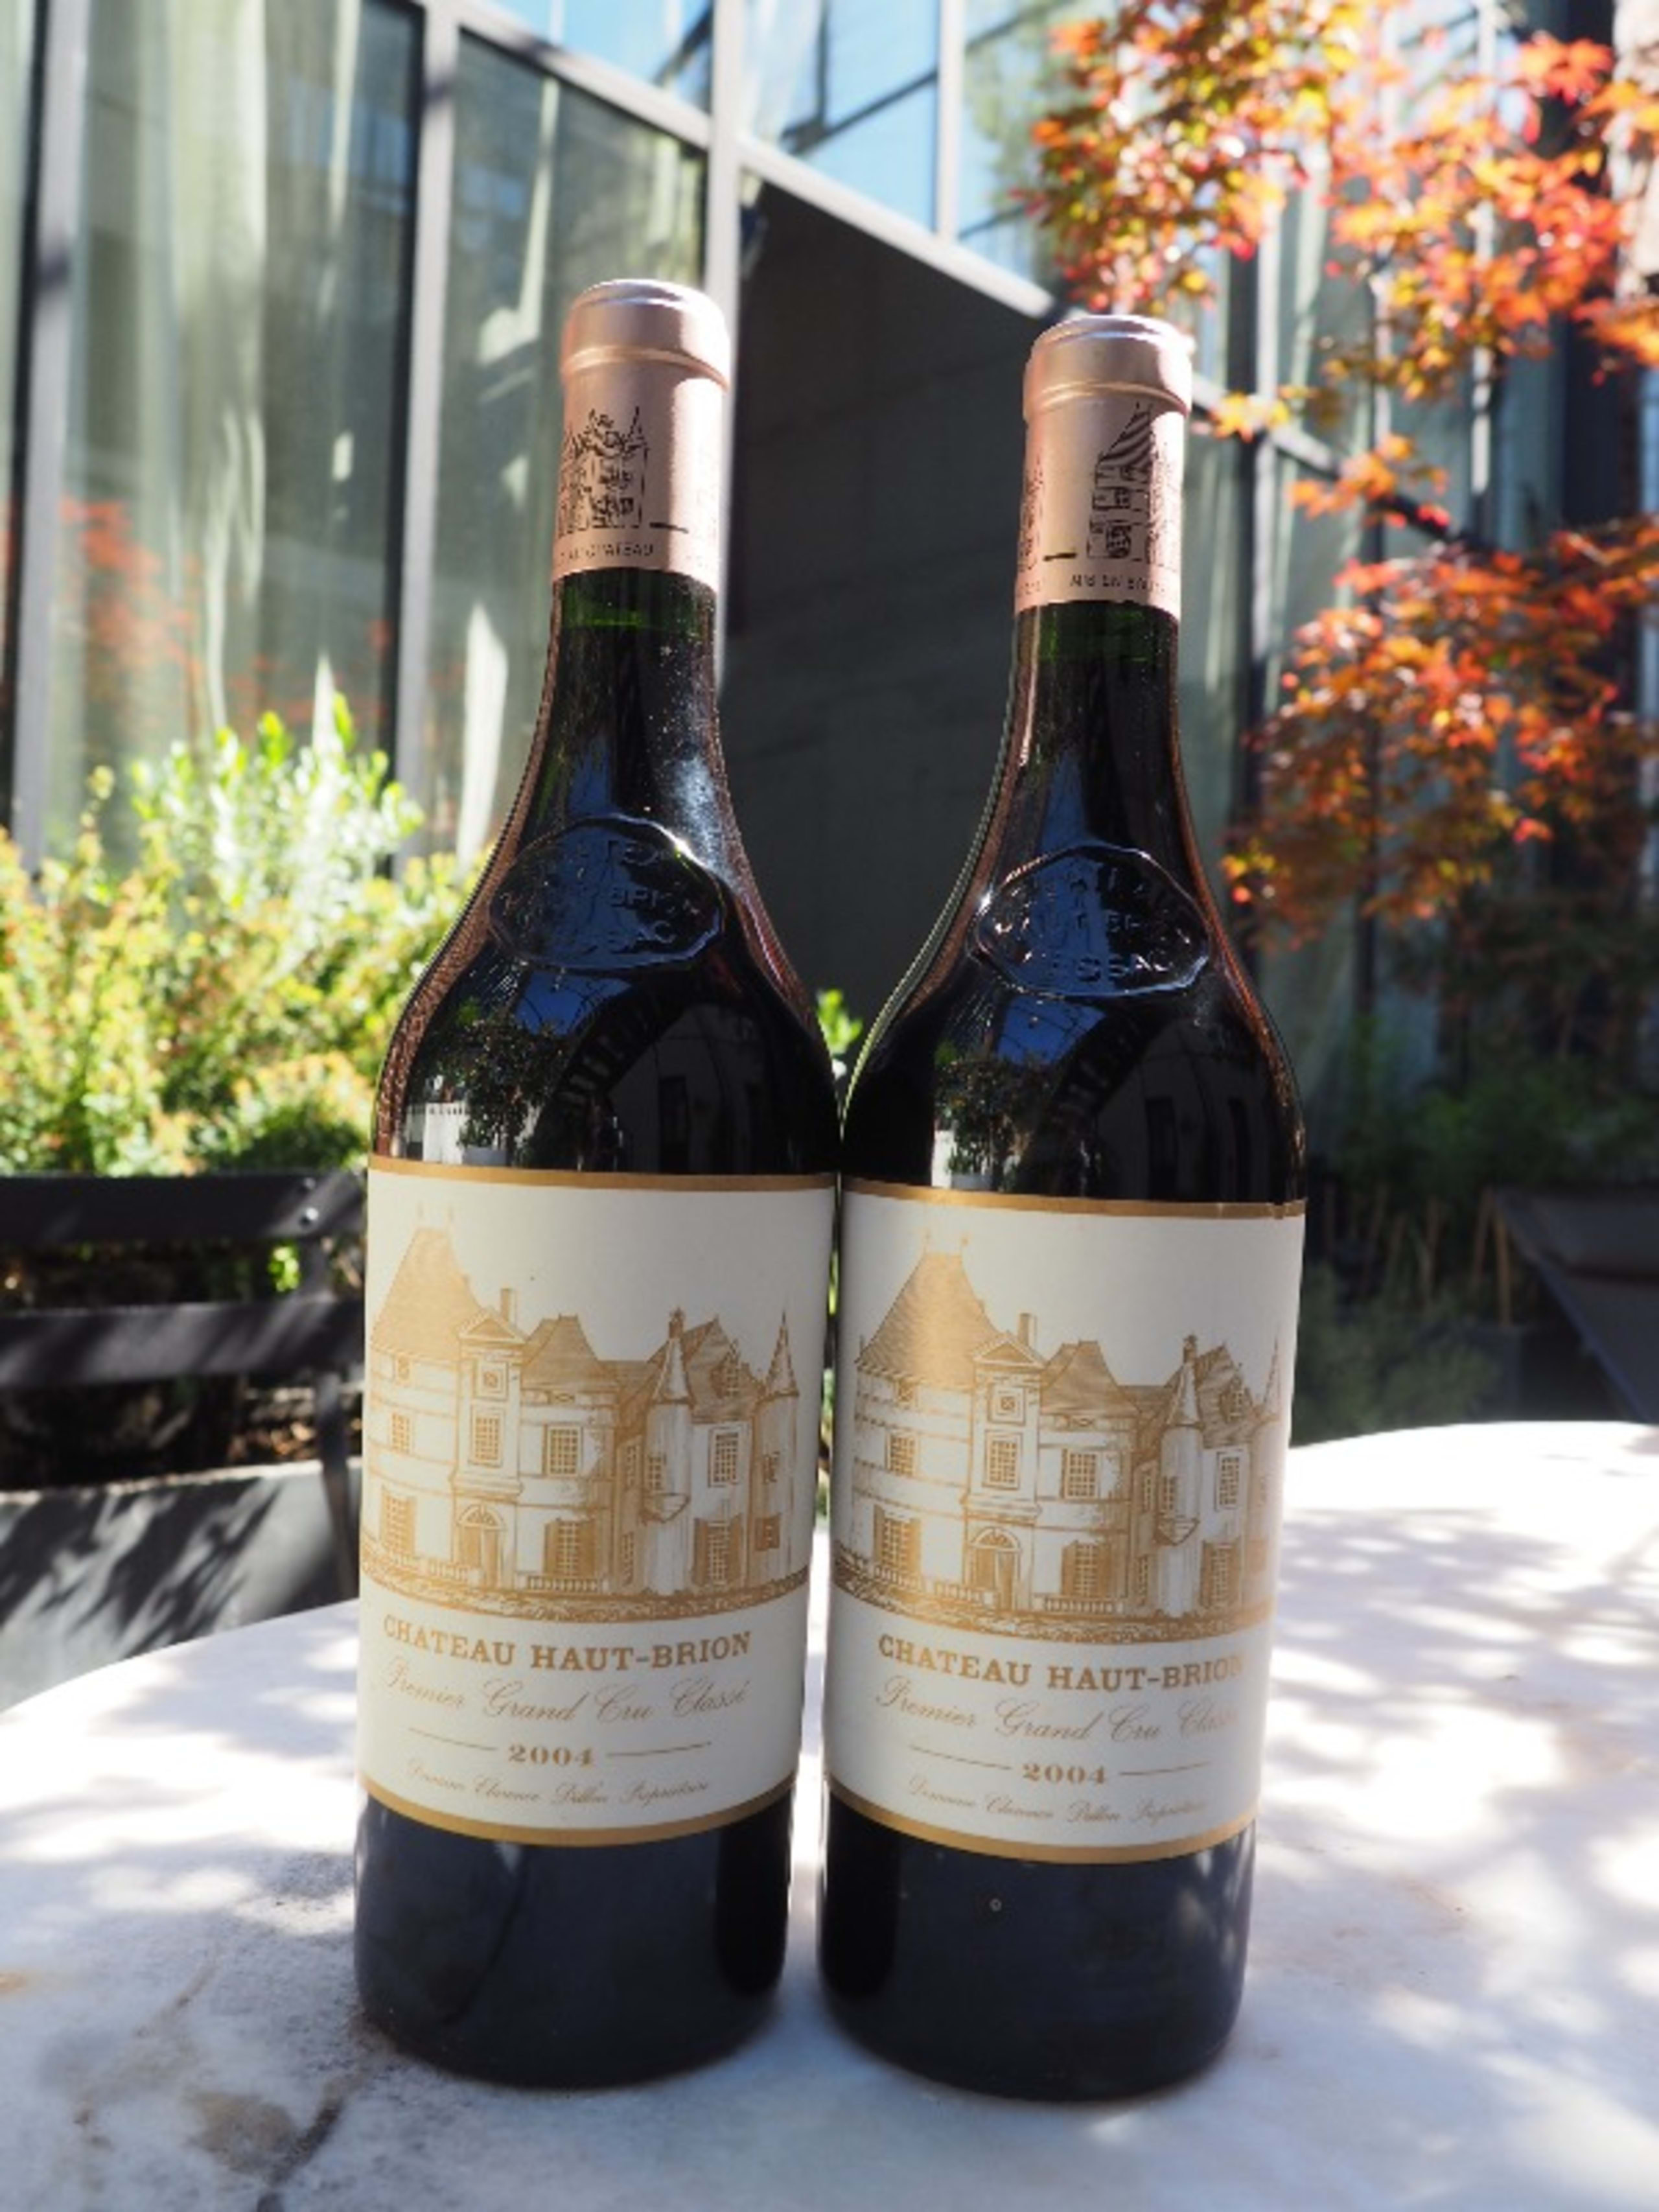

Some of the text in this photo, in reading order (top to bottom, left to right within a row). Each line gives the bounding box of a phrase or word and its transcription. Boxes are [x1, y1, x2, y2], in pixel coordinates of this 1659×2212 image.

[384, 1614, 750, 1671] CHATEAU HAUT-BRION
[878, 1633, 1244, 1692] CHATEAU HAUT-BRION
[481, 1678, 590, 1721] Grand
[594, 1684, 653, 1725] Cru
[876, 1675, 976, 1729] Premier
[995, 1698, 1105, 1740] Grand
[1108, 1702, 1161, 1743] Cru
[509, 1744, 592, 1766] 2004
[1022, 1763, 1105, 1785] 2004
